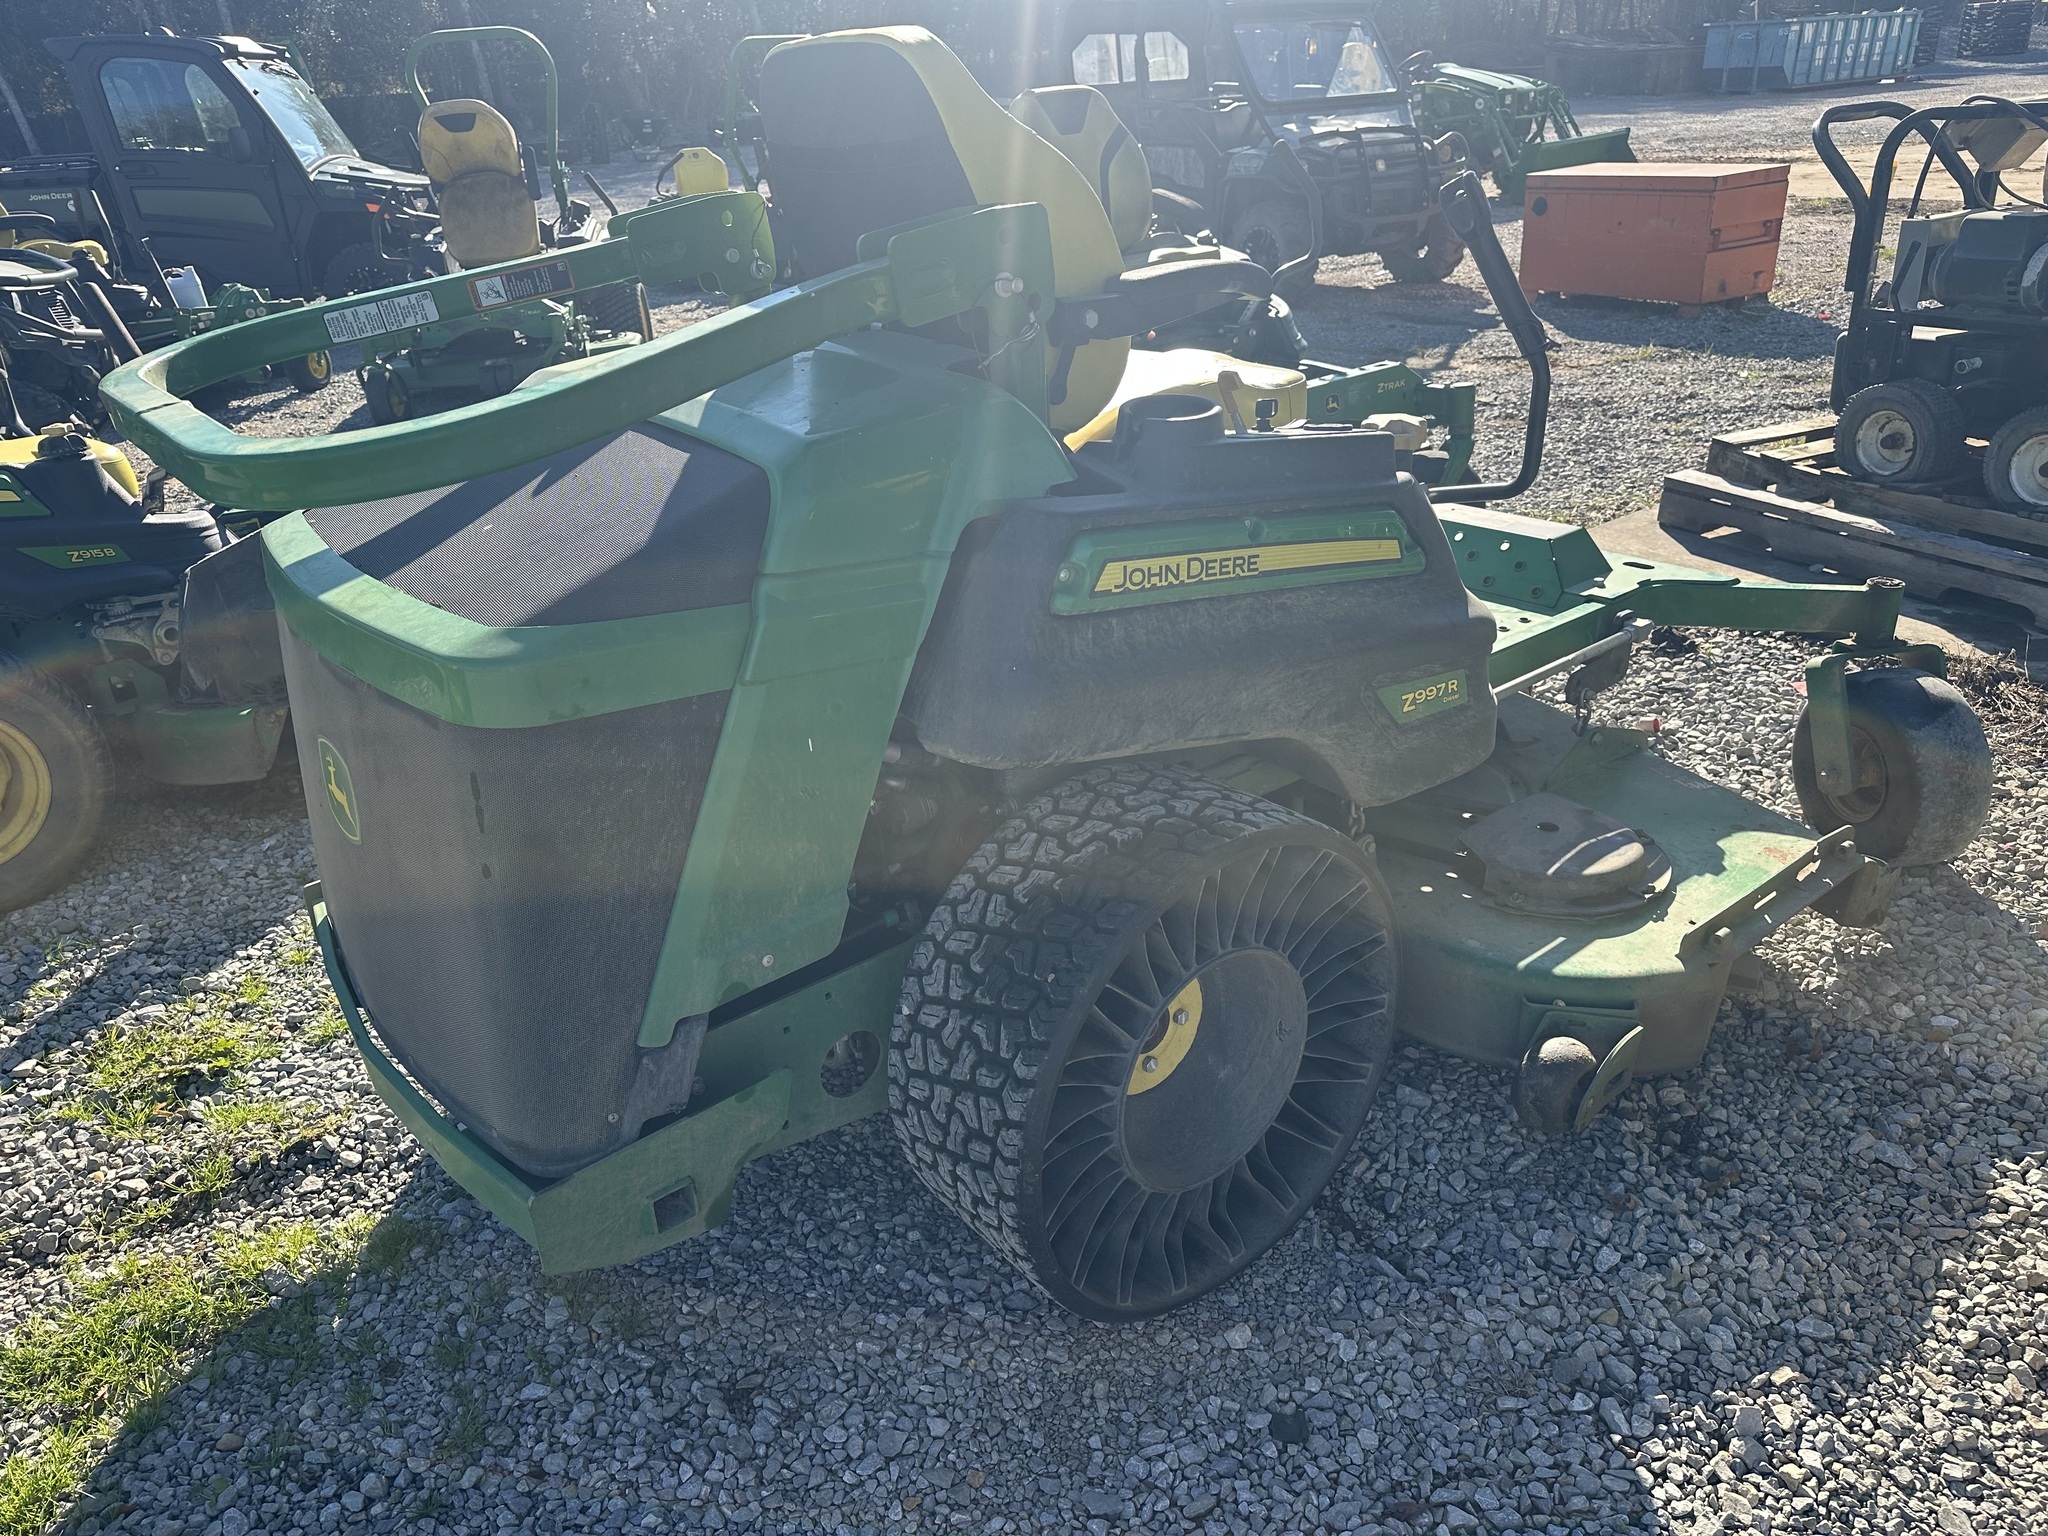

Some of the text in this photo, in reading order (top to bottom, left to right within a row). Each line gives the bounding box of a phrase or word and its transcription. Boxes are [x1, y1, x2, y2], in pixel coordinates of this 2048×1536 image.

[1804, 17, 1900, 43] WARRIOR
[1814, 42, 1883, 66] WASTE
[1377, 379, 1406, 393] ZTRAK
[1114, 554, 1260, 590] JOHN DEERE
[1442, 693, 1460, 703] Diesel
